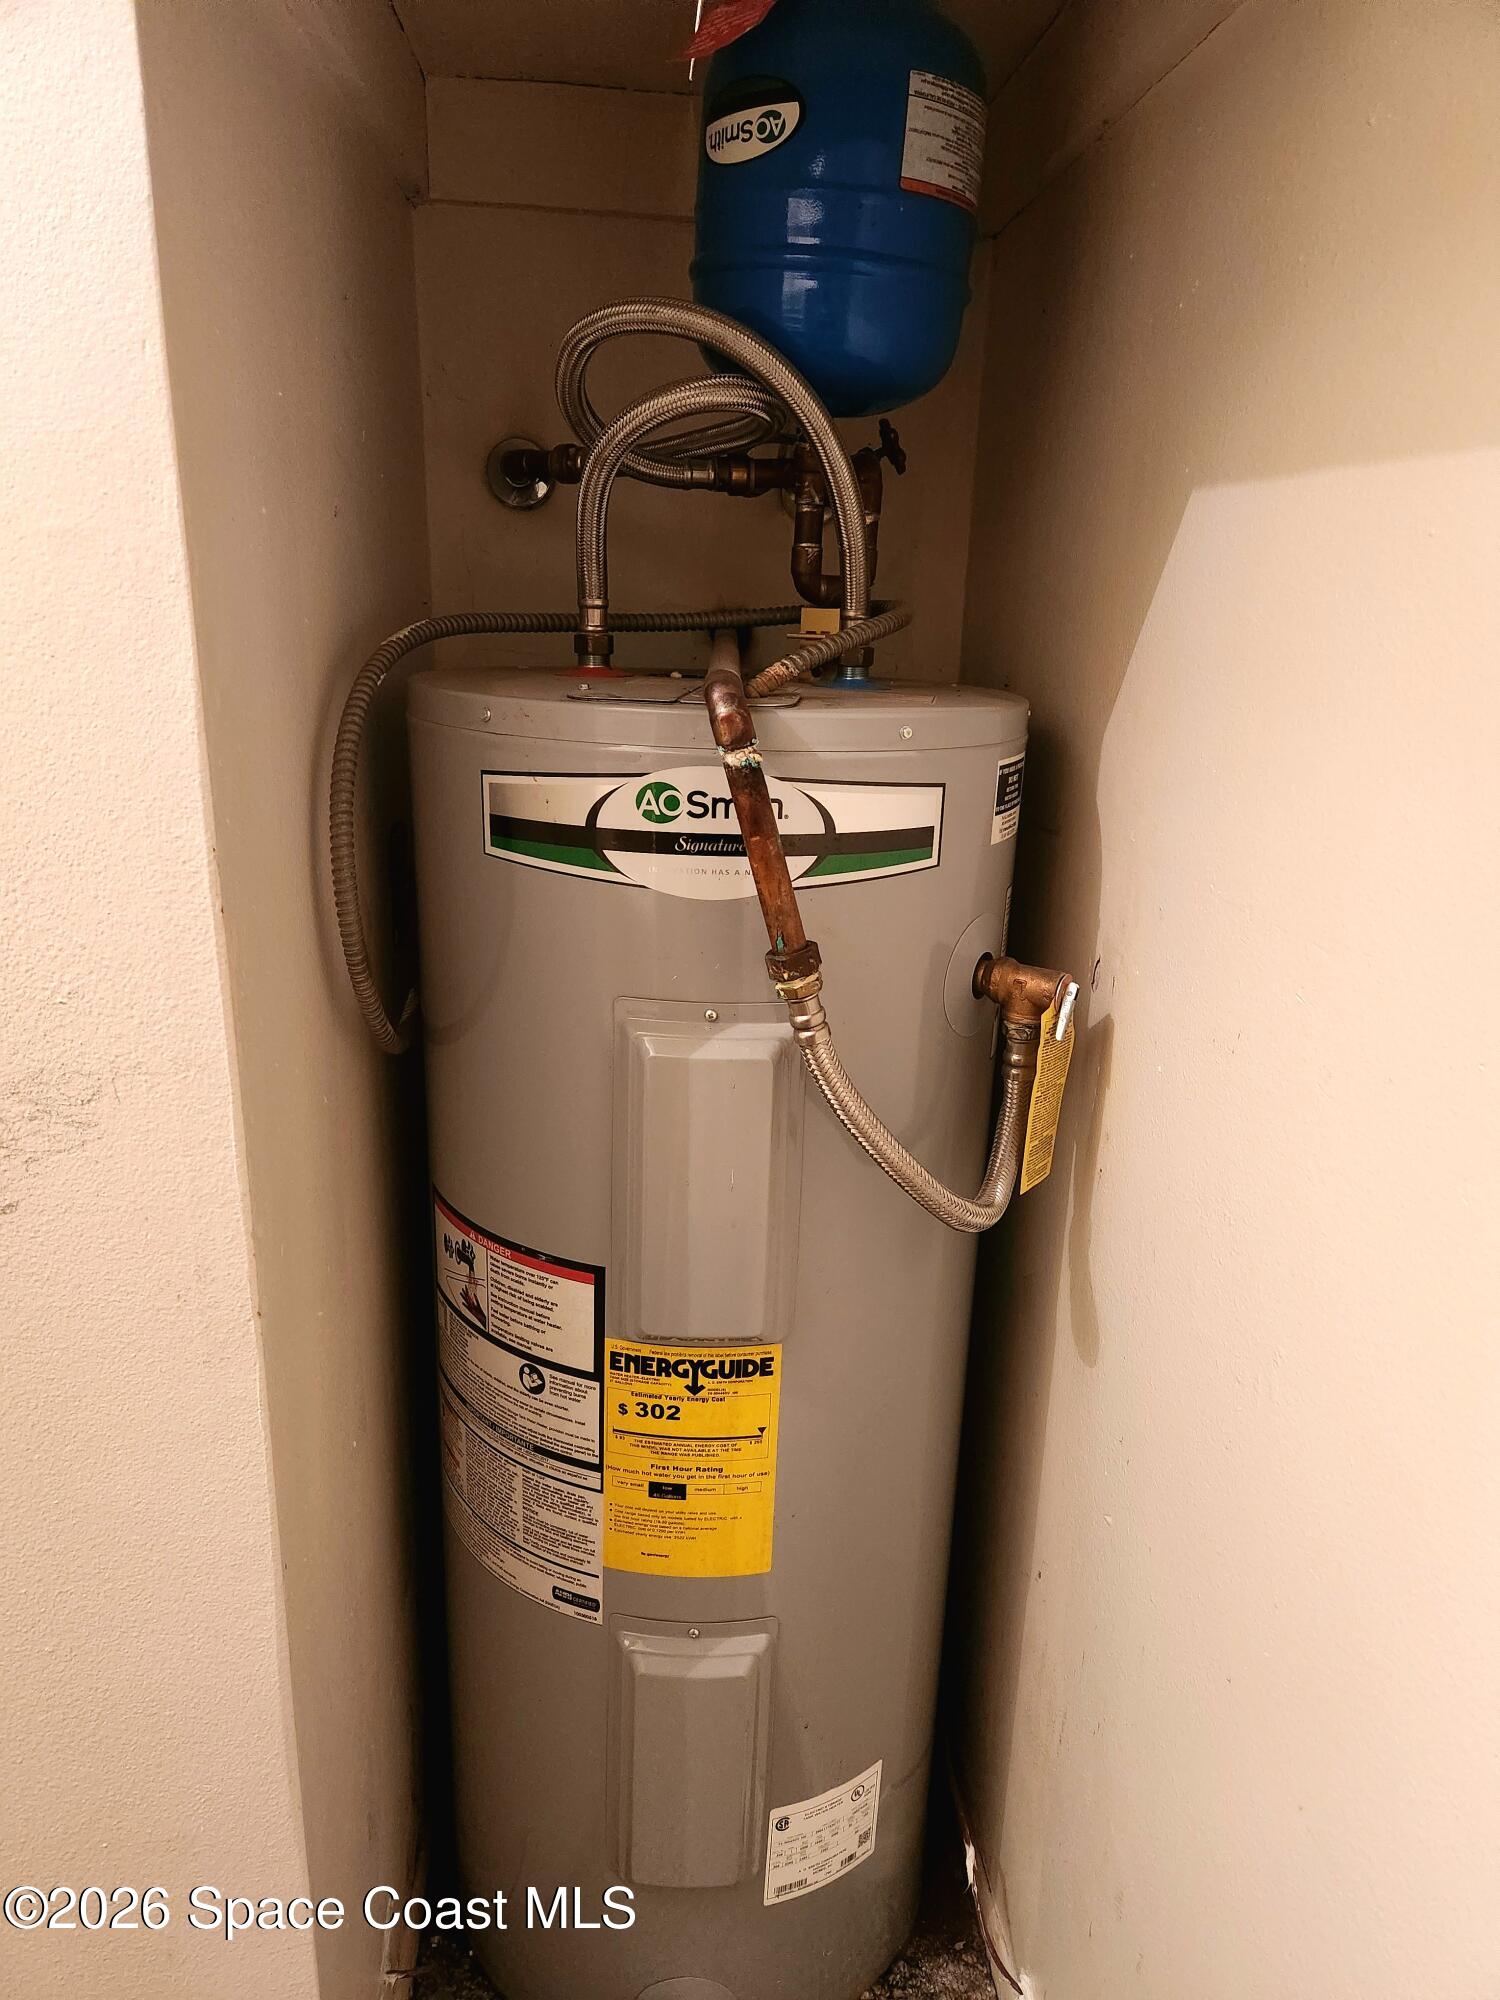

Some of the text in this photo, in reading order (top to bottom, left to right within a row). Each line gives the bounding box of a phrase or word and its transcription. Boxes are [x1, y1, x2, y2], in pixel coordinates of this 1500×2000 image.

[711, 868, 730, 876] HAS
[478, 1235, 512, 1260] DANGER
[609, 1350, 775, 1381] ENERGYGUIDE
[549, 1373, 558, 1381] See
[559, 1377, 575, 1386] manual
[549, 1379, 588, 1395] information about
[549, 1385, 586, 1400] preventing burns
[549, 1390, 559, 1398] from
[631, 1391, 662, 1400] Estimated
[664, 1394, 685, 1403] Yearly
[686, 1396, 709, 1404] Energy
[618, 1401, 681, 1421] $ 302
[495, 1426, 535, 1450] IMPORTANTE
[605, 1464, 621, 1472] (How
[622, 1467, 640, 1475] much
[650, 1463, 671, 1471] First
[695, 1466, 724, 1474] Rating
[616, 1479, 629, 1487] very
